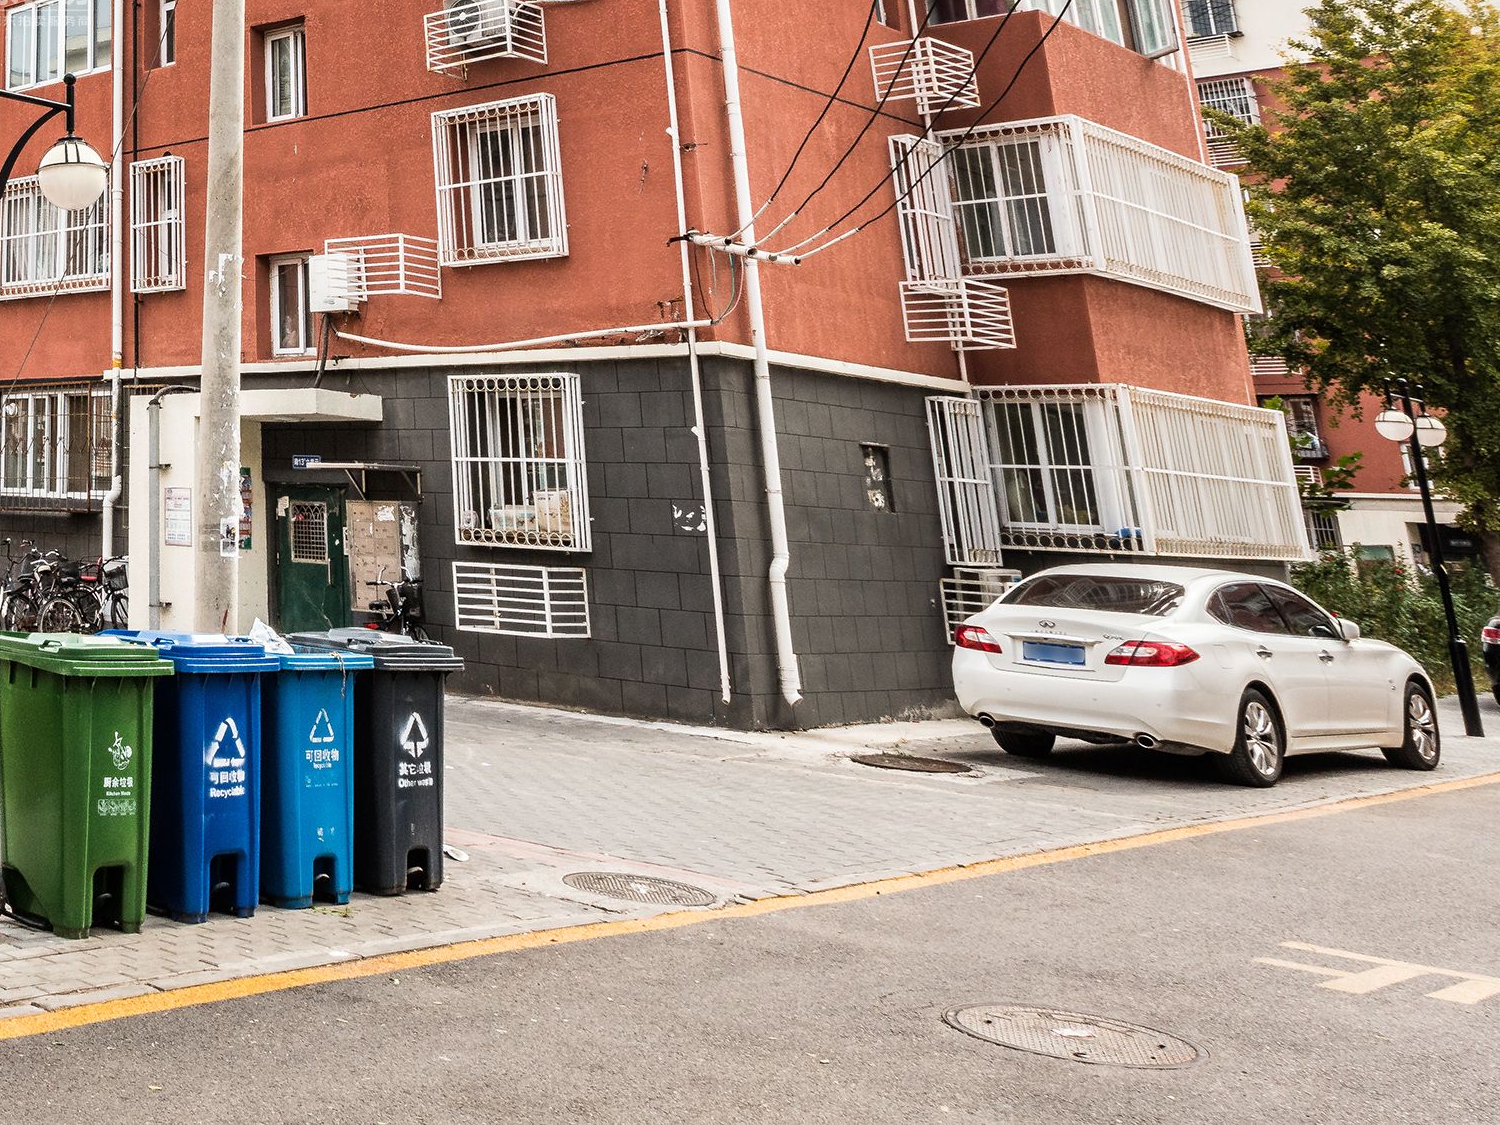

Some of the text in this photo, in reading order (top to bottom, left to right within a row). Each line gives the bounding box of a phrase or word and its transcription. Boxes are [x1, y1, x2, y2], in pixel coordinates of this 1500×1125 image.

[305, 748, 340, 762] 可回收物
[399, 761, 432, 776] 其它垃圾
[103, 776, 134, 788] 厨余垃圾
[209, 769, 245, 784] 可回收物
[398, 778, 416, 788] Other
[209, 785, 245, 798] Recyclable
